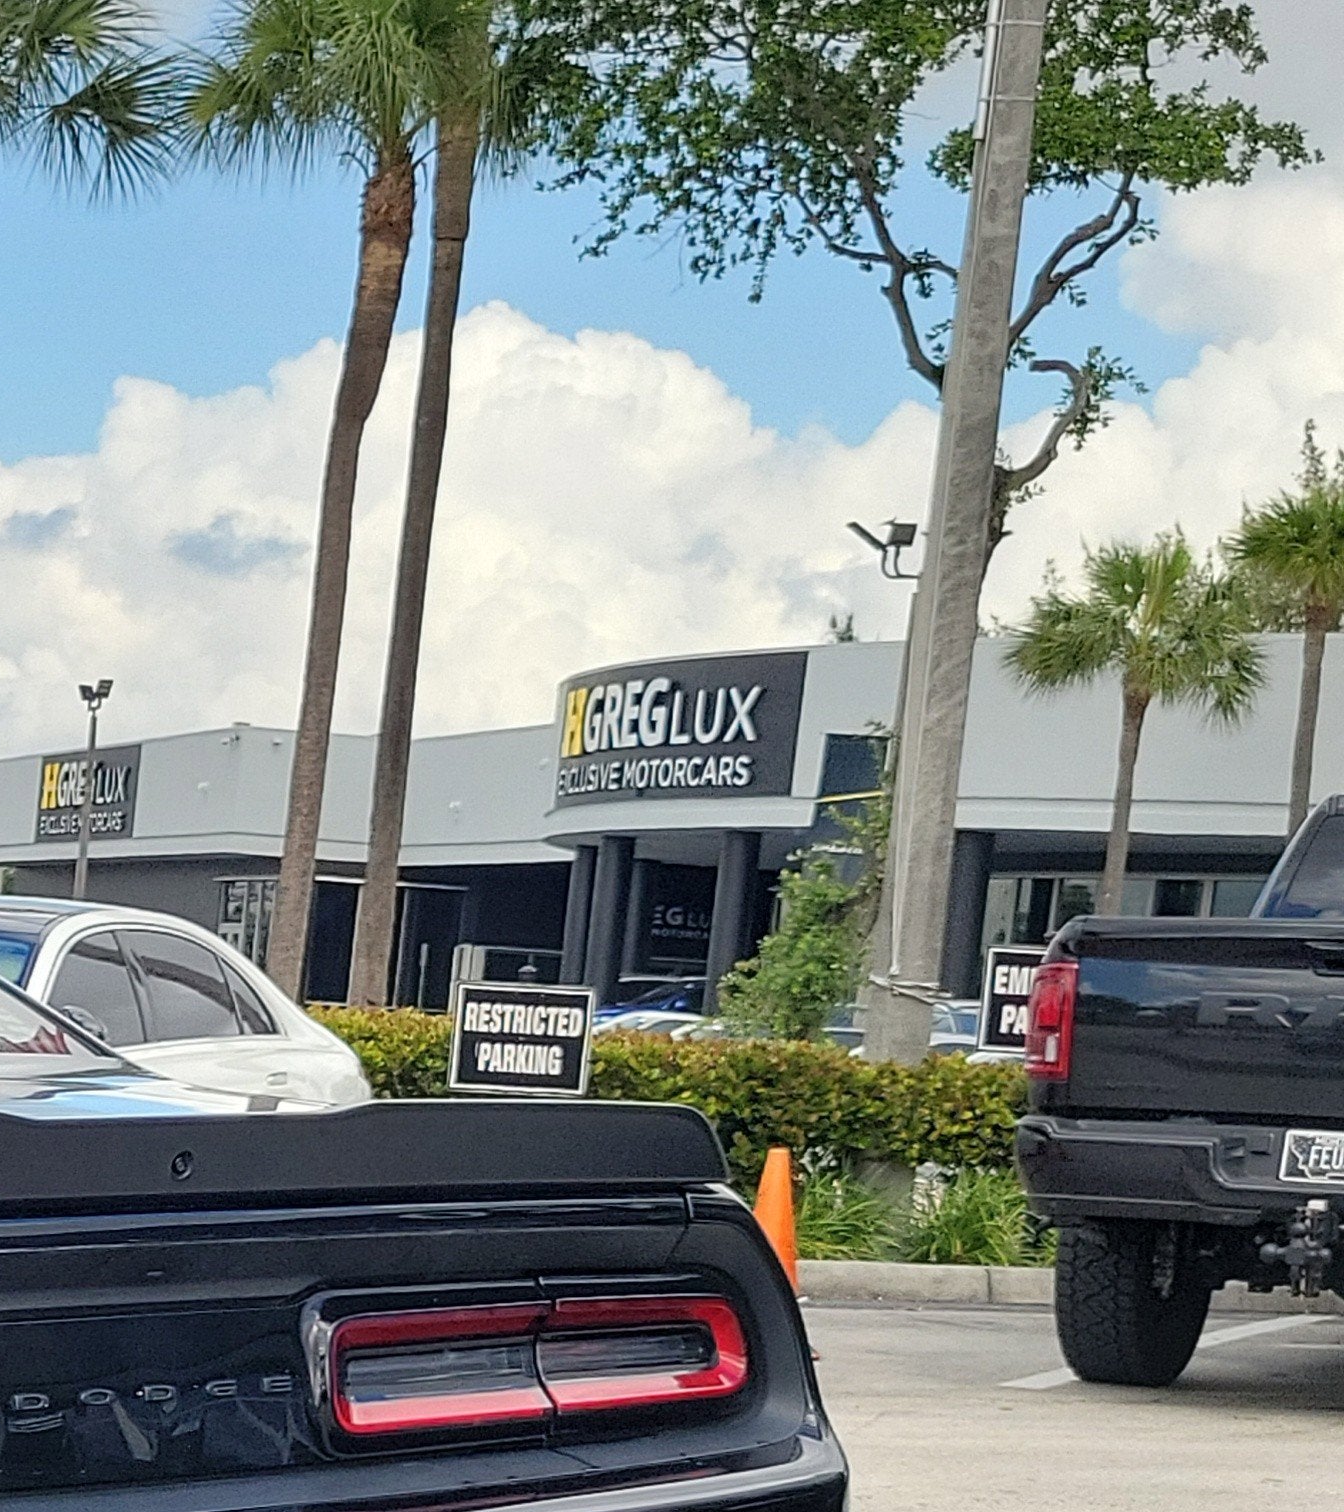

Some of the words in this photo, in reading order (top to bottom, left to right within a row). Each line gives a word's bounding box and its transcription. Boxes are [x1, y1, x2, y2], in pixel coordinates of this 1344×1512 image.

[561, 677, 670, 758] HGREG
[669, 685, 762, 745] LUX
[95, 765, 128, 804] LUX
[622, 754, 752, 788] MOTORCARS
[463, 1002, 584, 1037] RESTRICTED
[476, 1042, 563, 1075] PARKING
[13, 1373, 294, 1411] DODGE
